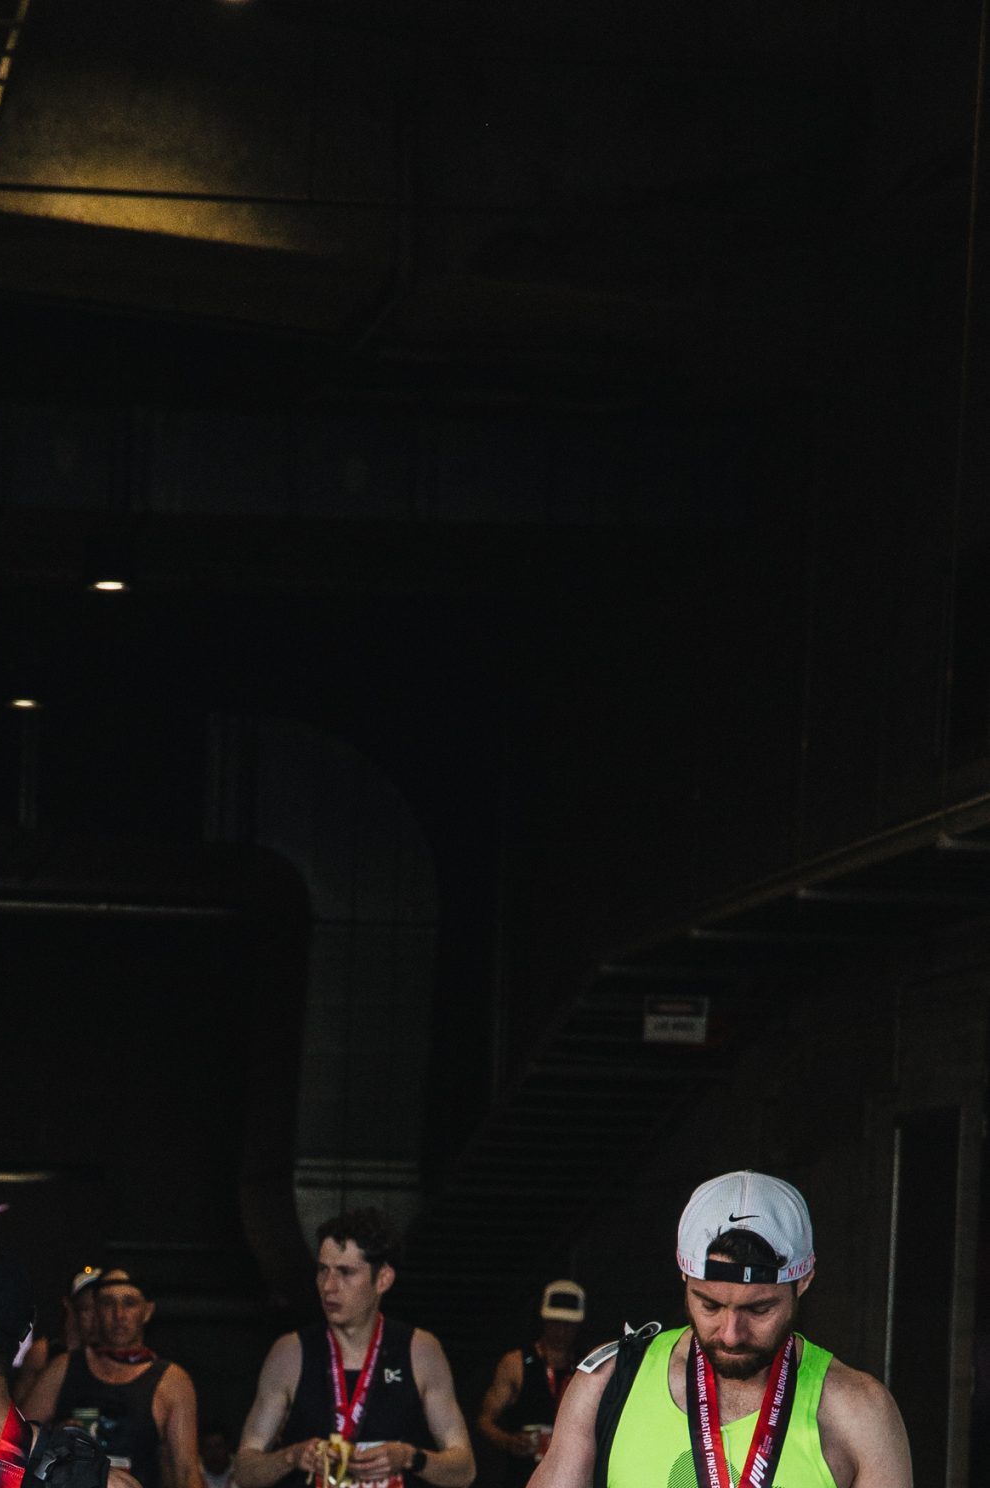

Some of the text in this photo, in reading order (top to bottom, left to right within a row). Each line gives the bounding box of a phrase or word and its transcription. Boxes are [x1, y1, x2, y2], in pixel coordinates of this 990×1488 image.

[696, 1354, 708, 1403] MELBOURNE
[773, 1359, 790, 1407] MELBOURNE
[699, 1404, 714, 1451] MARATHON
[768, 1408, 780, 1427] NIKE
